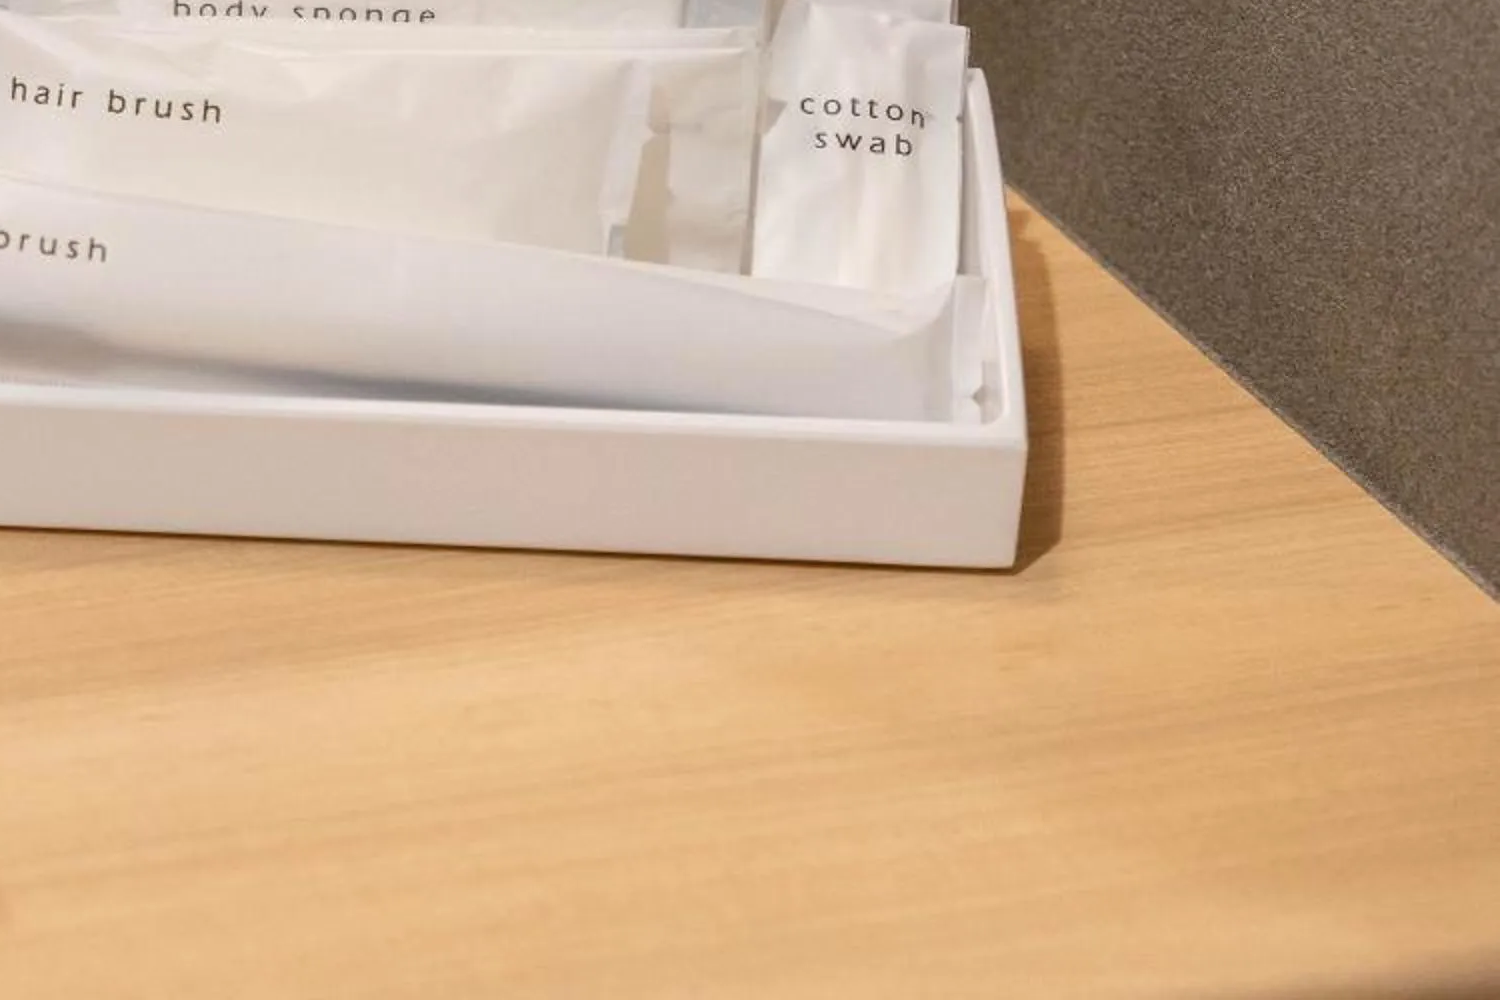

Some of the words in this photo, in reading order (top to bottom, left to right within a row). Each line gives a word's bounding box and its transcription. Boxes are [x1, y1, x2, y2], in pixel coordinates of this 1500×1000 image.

[10, 76, 84, 109] hair
[107, 89, 223, 124] brush
[799, 96, 926, 129] cotton
[815, 131, 914, 157] swab
